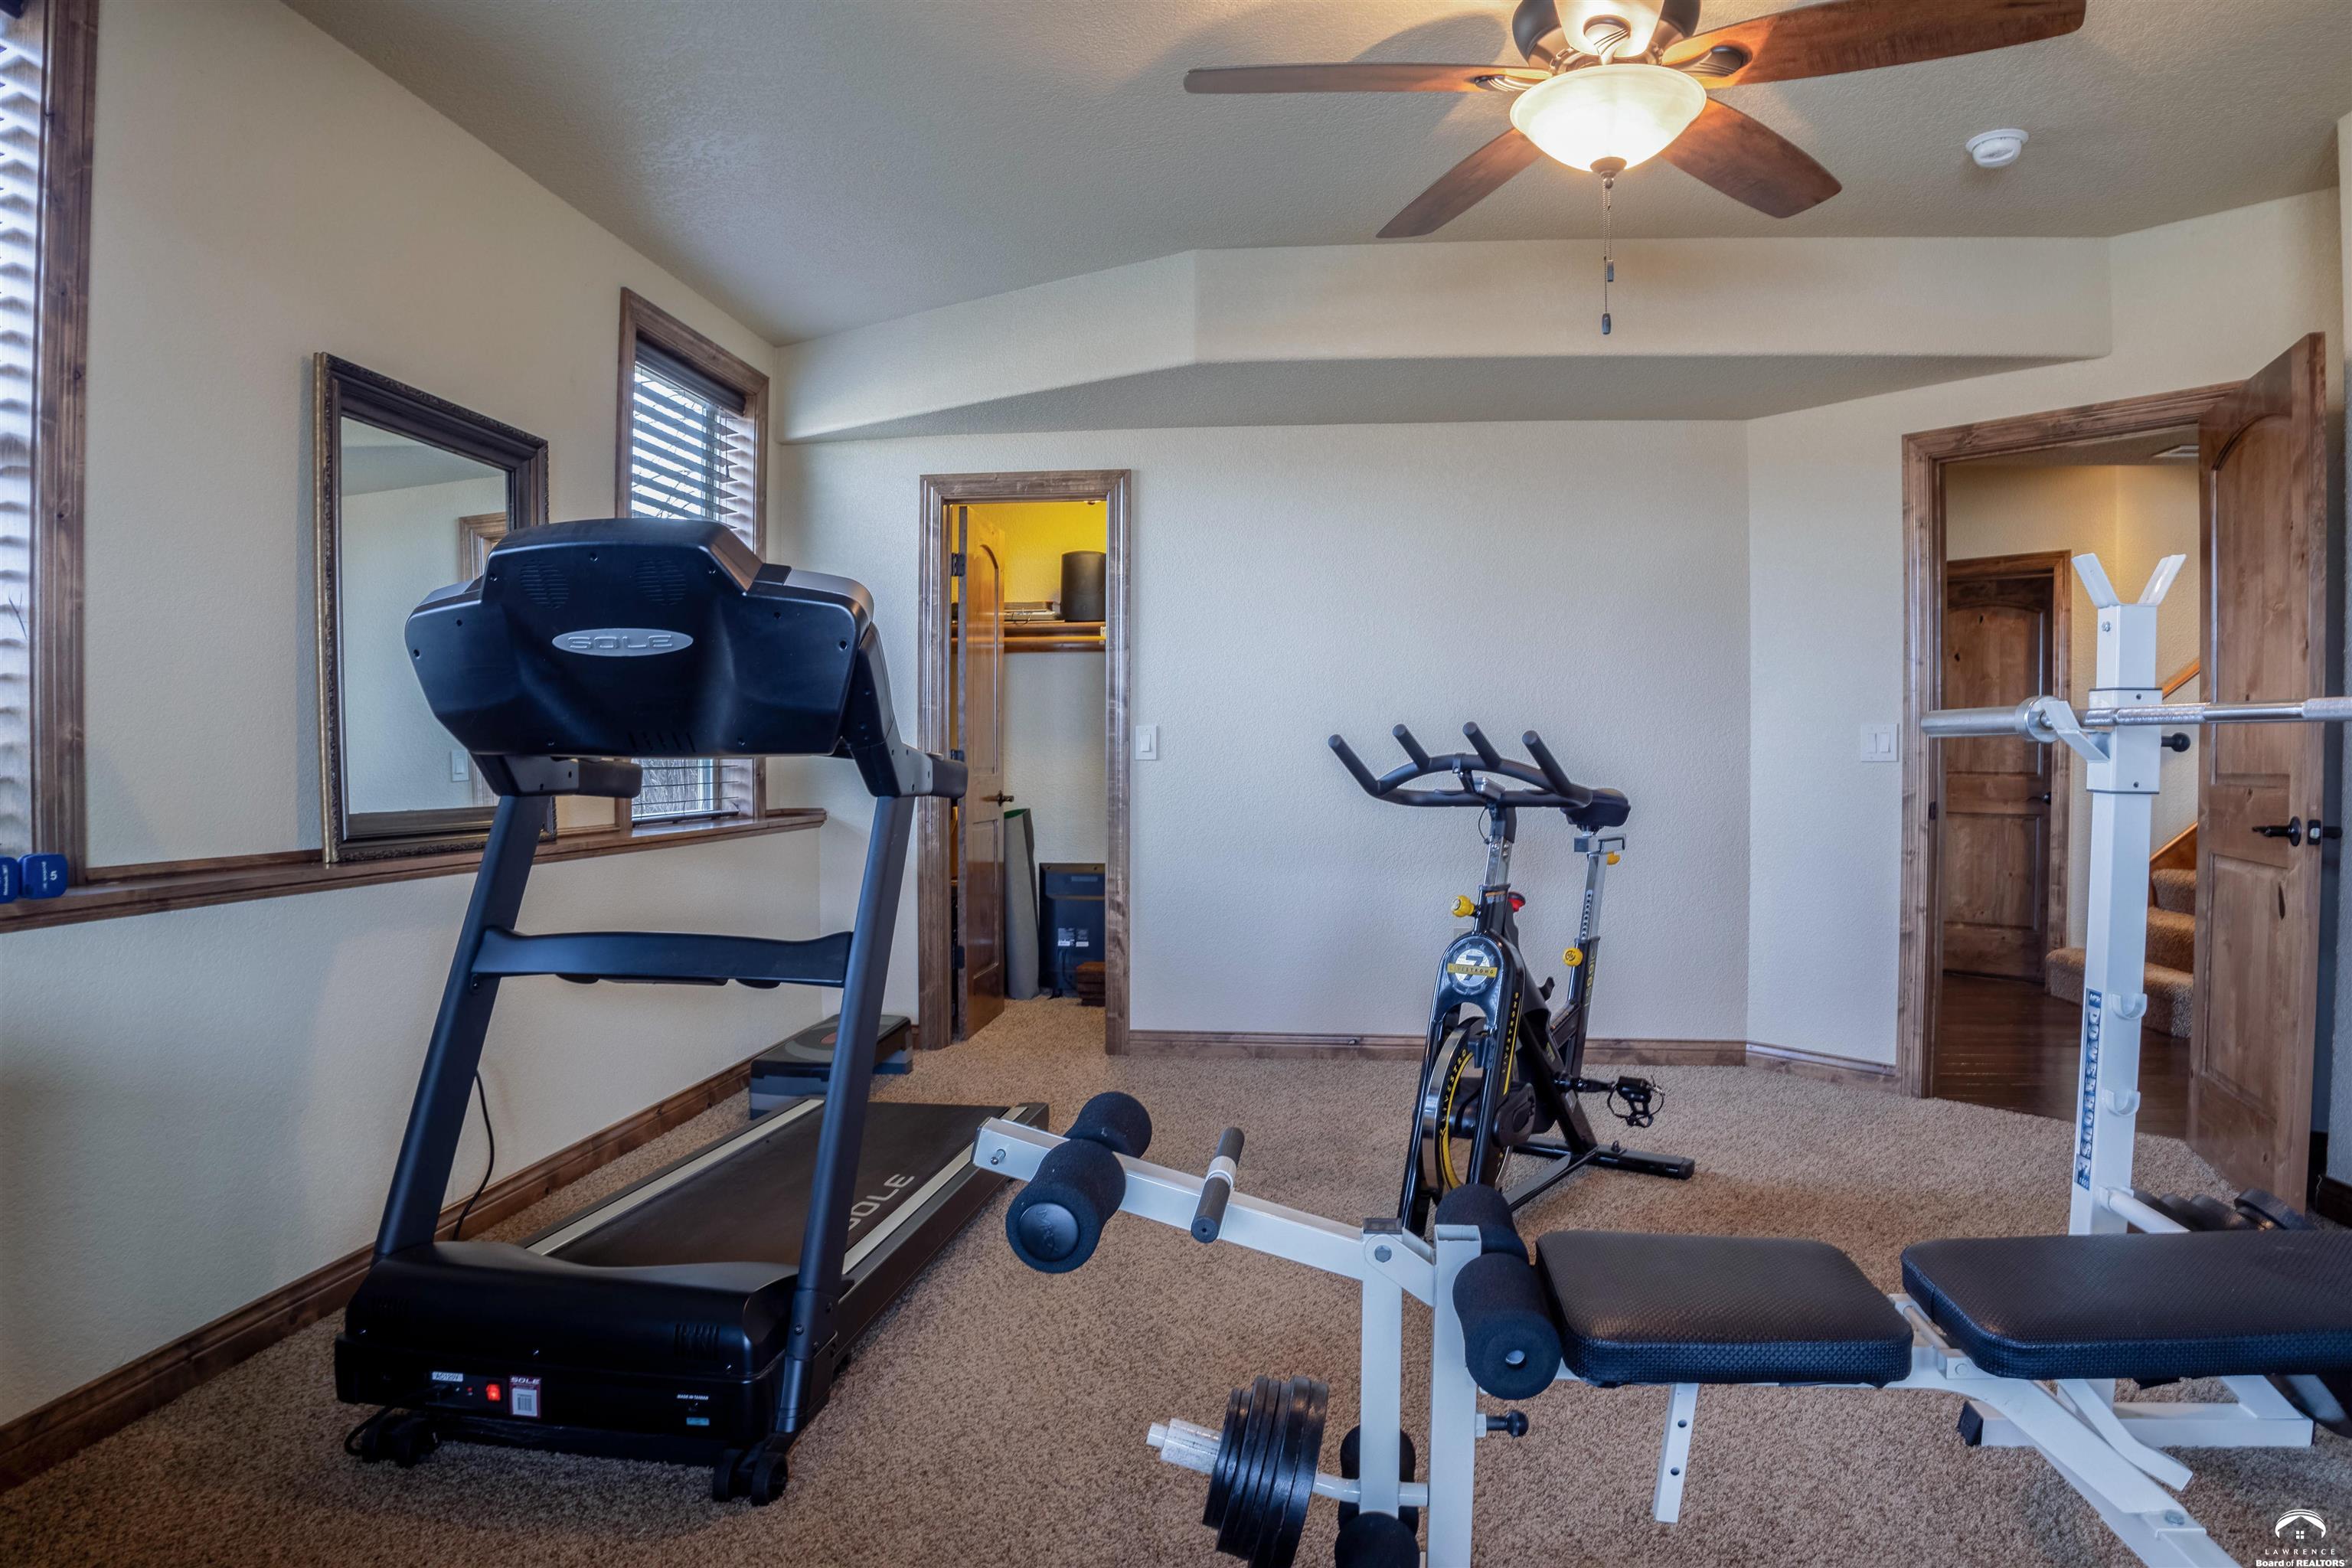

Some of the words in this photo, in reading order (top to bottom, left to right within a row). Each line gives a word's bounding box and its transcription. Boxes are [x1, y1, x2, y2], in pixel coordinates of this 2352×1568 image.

[567, 635, 673, 650] SOLE
[50, 870, 58, 881] 5
[1449, 964, 1494, 975] LIVESTRONG
[1464, 955, 1484, 981] 7
[1501, 991, 1519, 1075] LIVESTRONG
[1440, 1048, 1467, 1122] LIVESTRO
[2076, 1007, 2100, 1177] POWERHOUSE
[511, 1376, 541, 1385] SOLE
